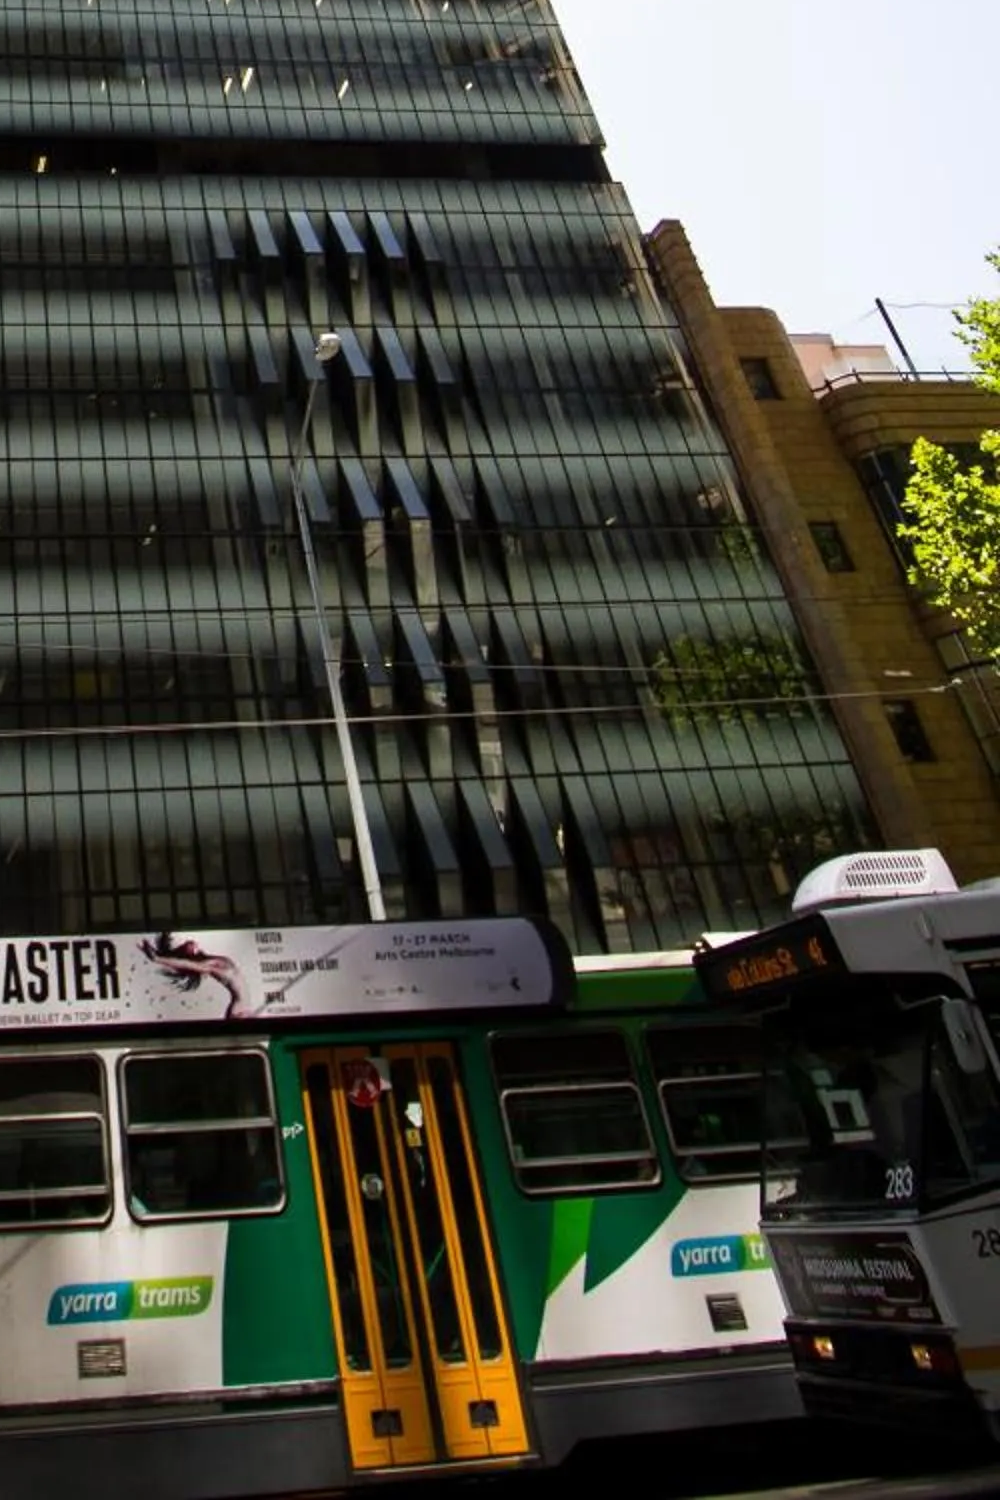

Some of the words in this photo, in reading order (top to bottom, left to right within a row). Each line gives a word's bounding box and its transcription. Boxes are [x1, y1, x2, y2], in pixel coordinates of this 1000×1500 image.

[429, 934, 471, 944] MARCH
[24, 1012, 59, 1025] BALLET
[62, 1012, 73, 1023] IN
[884, 1164, 914, 1199] 283
[680, 1244, 732, 1273] yarra
[60, 1290, 118, 1320] yarra
[138, 1284, 202, 1308] trams
